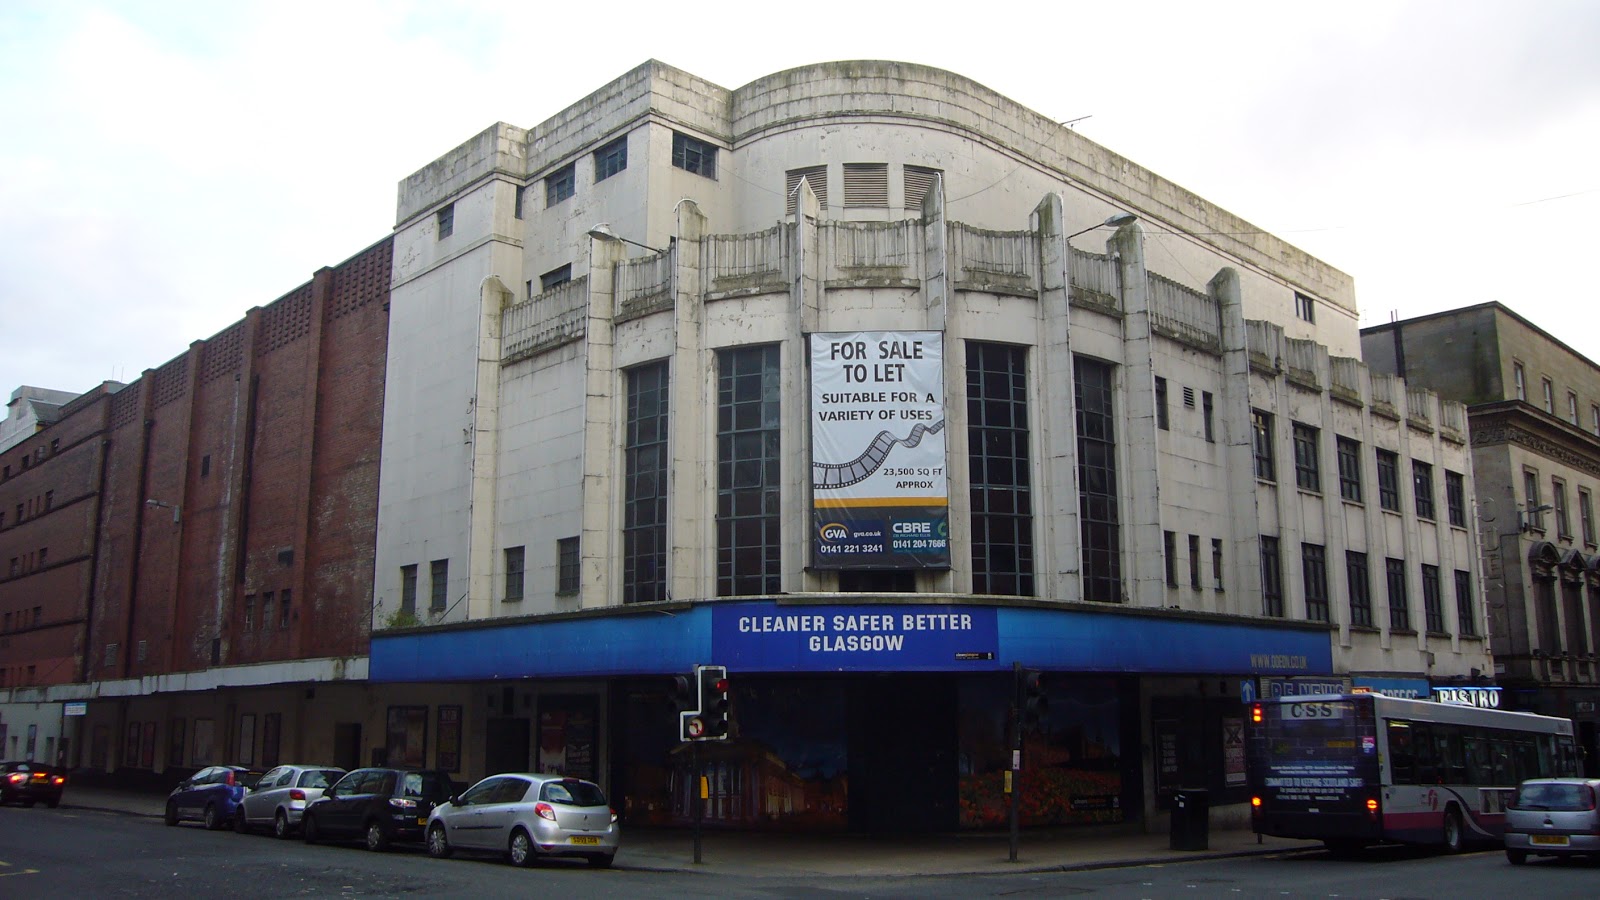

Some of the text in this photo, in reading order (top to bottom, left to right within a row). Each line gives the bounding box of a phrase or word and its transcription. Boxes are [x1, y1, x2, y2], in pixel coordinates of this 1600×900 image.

[831, 341, 923, 360] FOR SALE
[843, 364, 905, 383] TO LET
[822, 392, 935, 403] SUITABLE FOR A
[819, 410, 932, 421] VARIETY OF USES
[883, 468, 914, 476] 23,500
[917, 468, 930, 476] SQ
[892, 522, 931, 533] CBRE
[825, 529, 847, 539] GVA
[820, 544, 883, 553] 0141 221 3241
[893, 540, 911, 548] 0141
[912, 540, 927, 548] 204
[739, 614, 972, 633] CLEANER SAFER BETTER
[809, 635, 904, 651] GLASGOW
[1439, 689, 1498, 708] BISTRO
